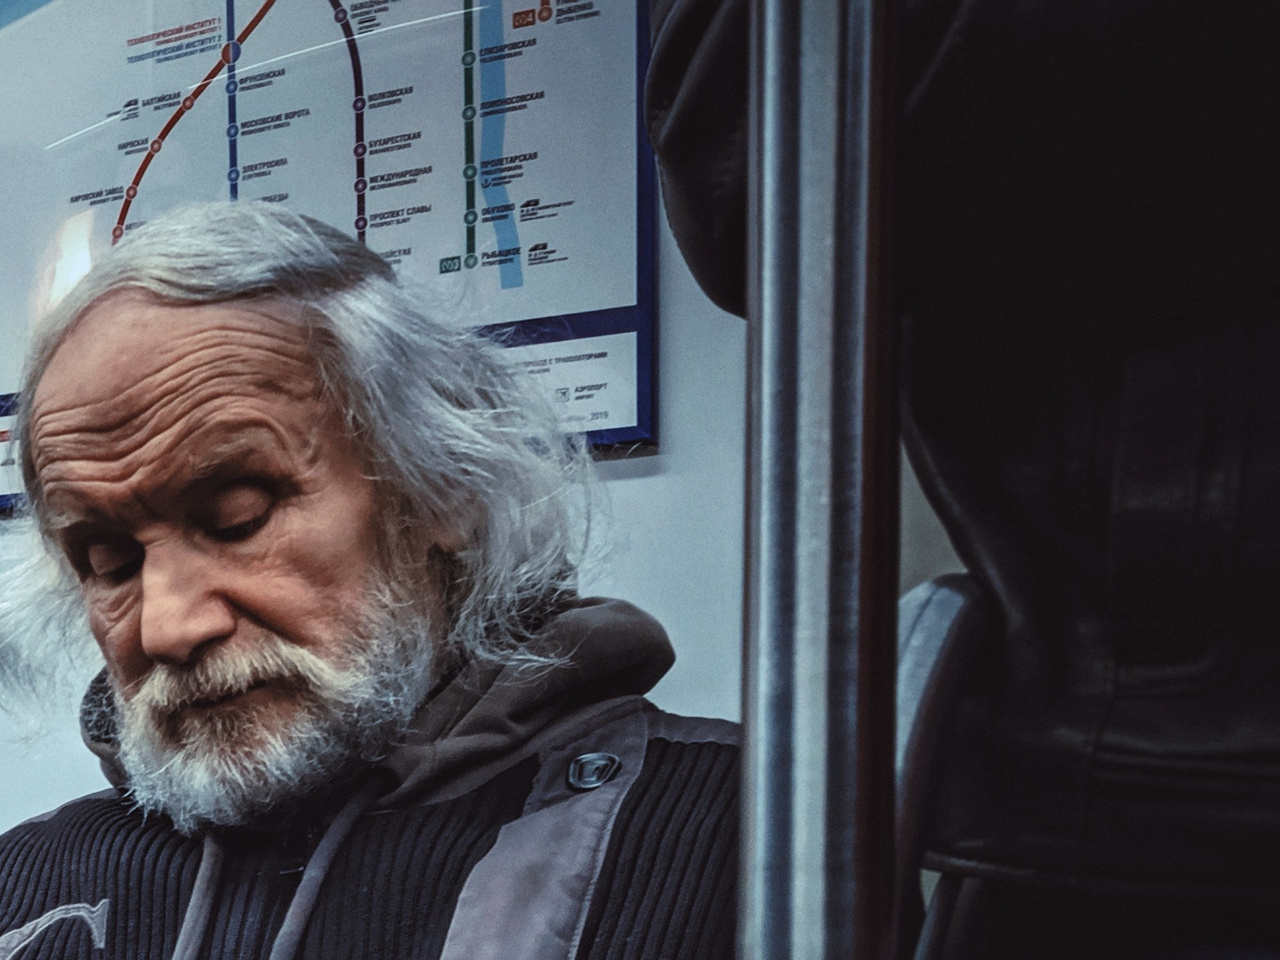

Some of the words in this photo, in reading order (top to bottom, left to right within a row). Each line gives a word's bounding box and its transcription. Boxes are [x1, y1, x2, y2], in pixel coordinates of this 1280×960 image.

[370, 208, 405, 222] ПРОСПЕКТ
[406, 204, 432, 216] СЛАВЫ
[591, 411, 609, 421] 2019
